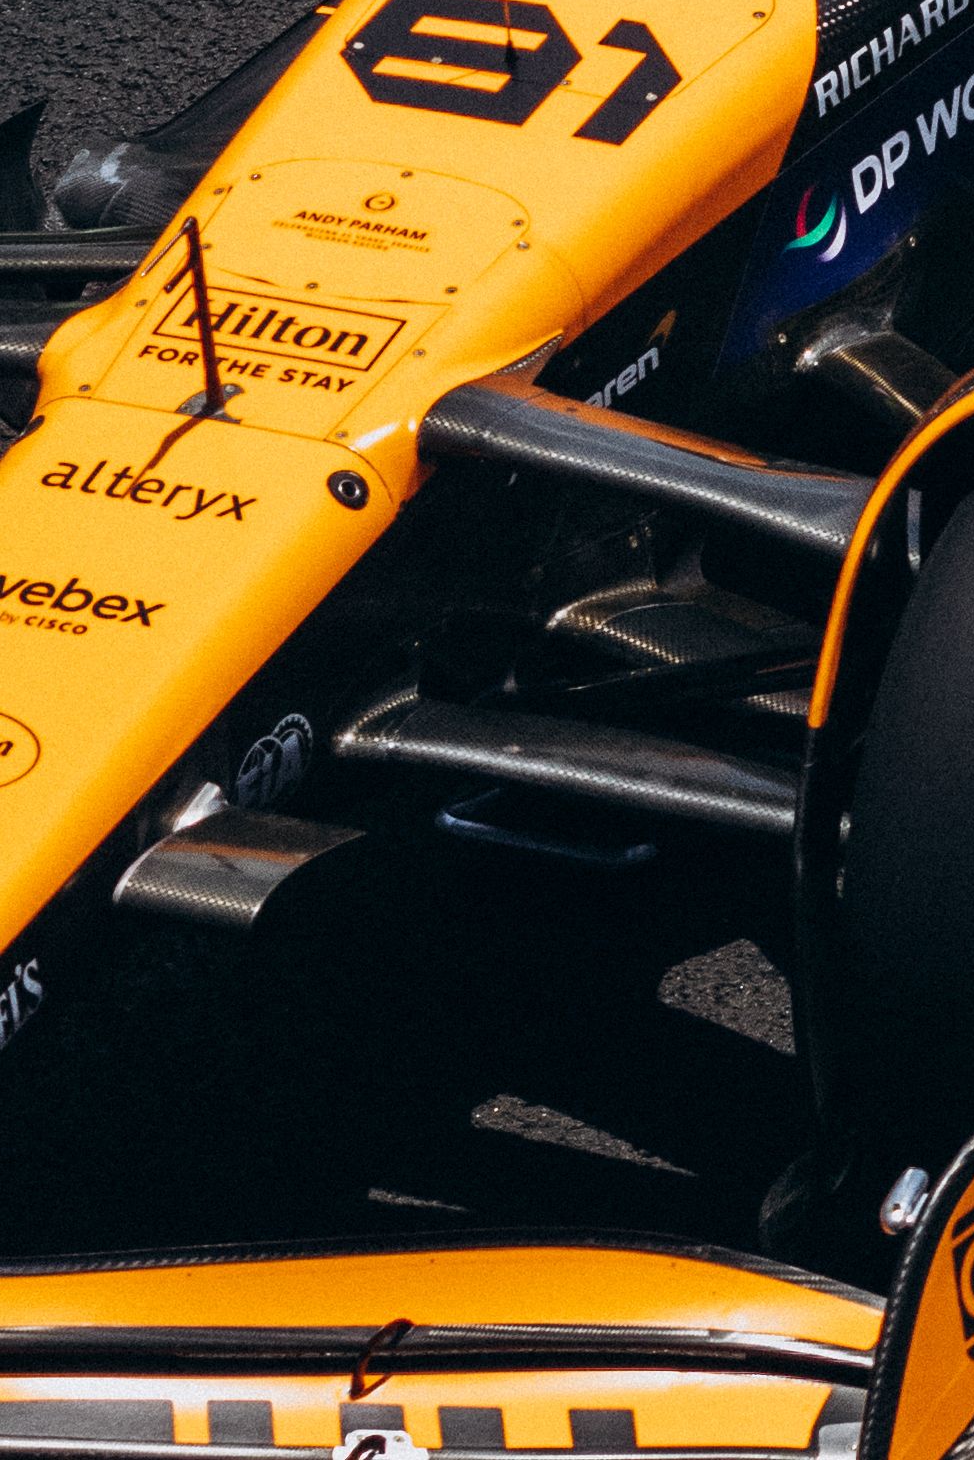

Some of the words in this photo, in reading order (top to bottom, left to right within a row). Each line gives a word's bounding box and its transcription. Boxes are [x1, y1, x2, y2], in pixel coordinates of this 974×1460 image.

[851, 129, 911, 215] DP
[294, 210, 347, 226] ANDY
[348, 219, 428, 241] PARHAM
[180, 297, 368, 357] Hilton
[138, 344, 200, 366] FOR
[213, 356, 271, 378] THE
[278, 368, 355, 393] STAY
[41, 460, 257, 521] alteryx
